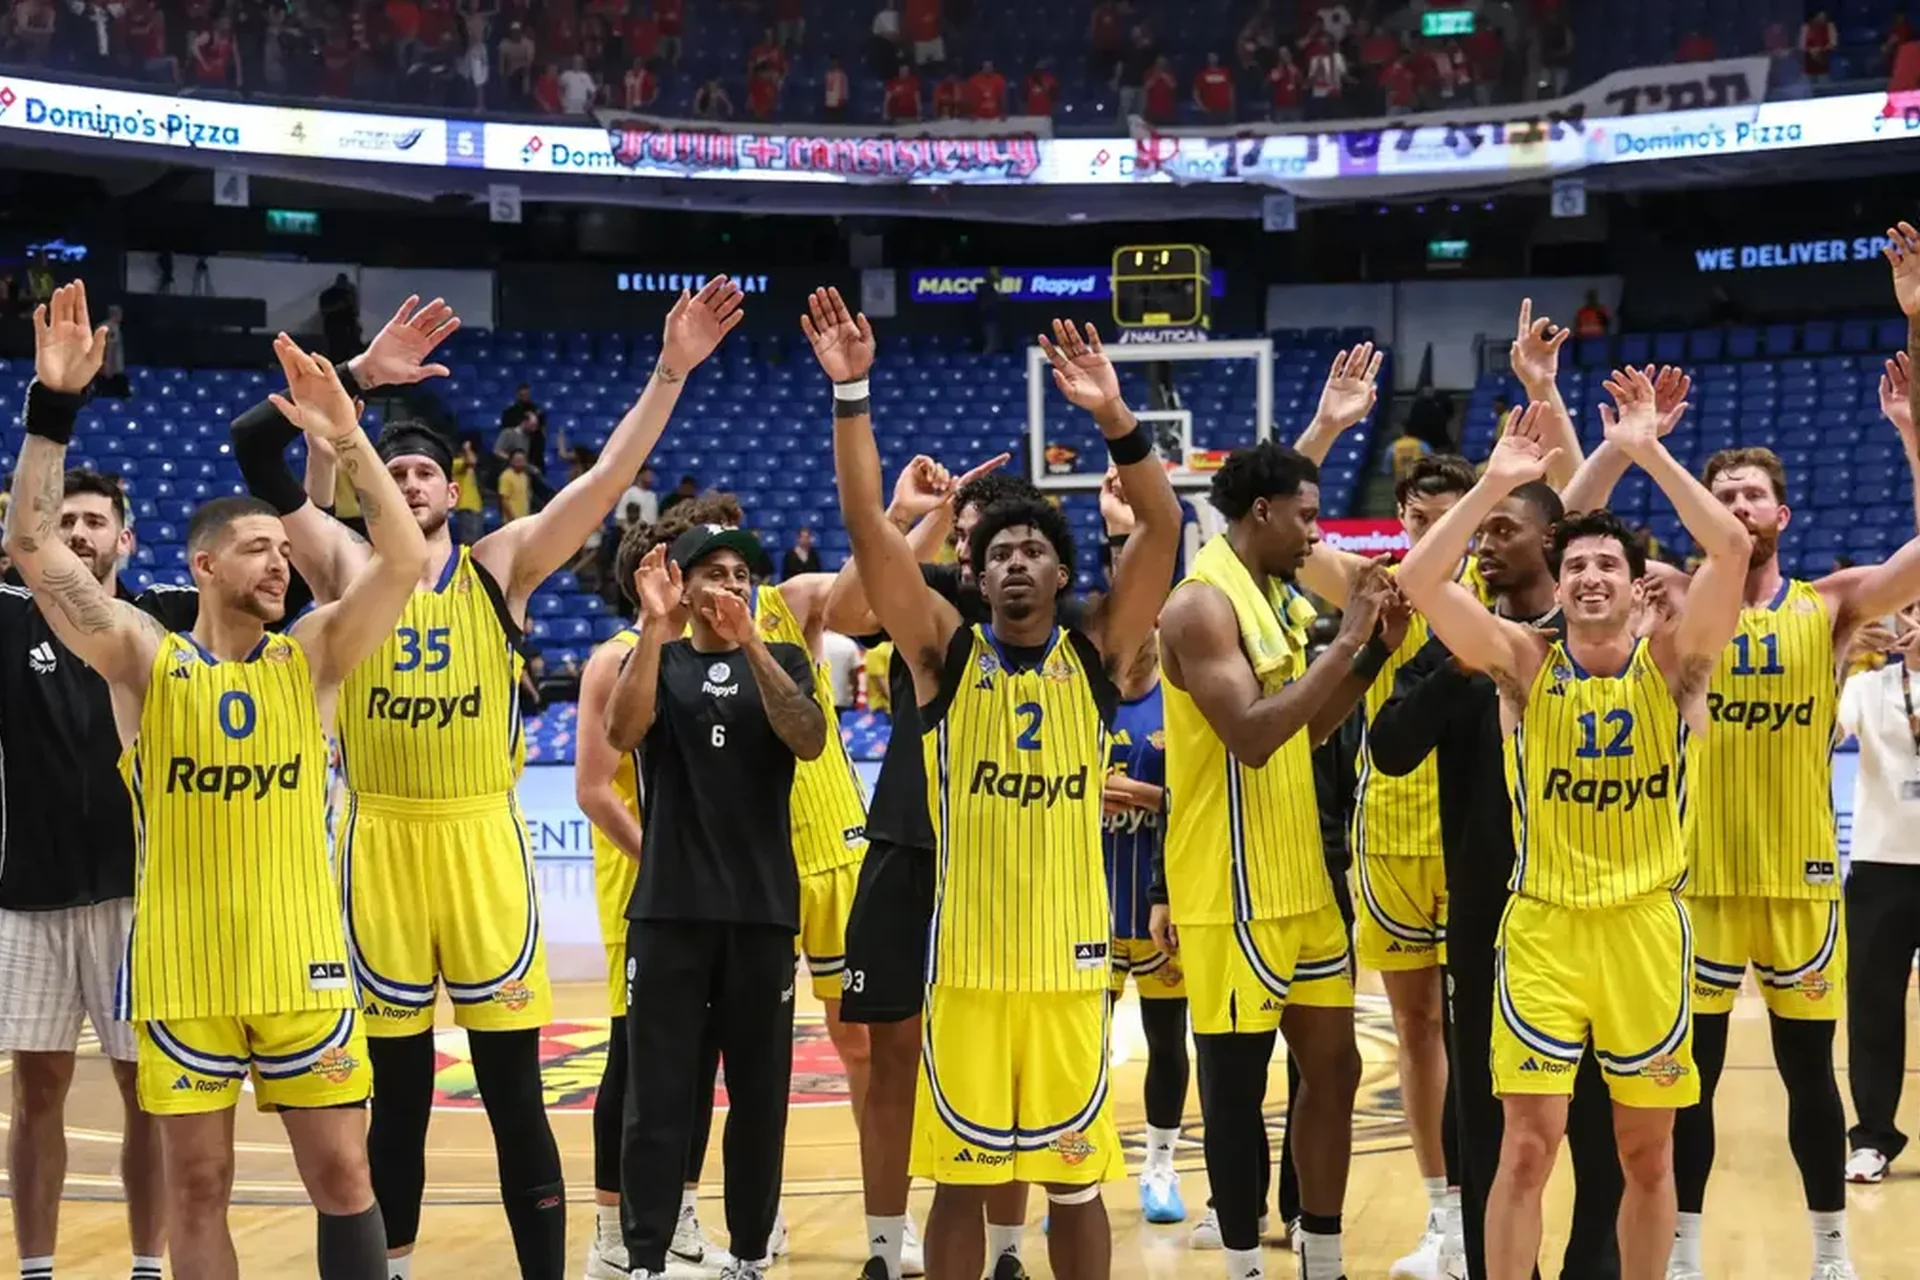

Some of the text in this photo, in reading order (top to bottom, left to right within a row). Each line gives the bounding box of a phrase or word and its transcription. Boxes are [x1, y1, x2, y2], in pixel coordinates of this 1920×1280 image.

[25, 97, 240, 145] Domino's Pizza
[1614, 122, 1801, 154] Domino's Pizza
[1695, 248, 1735, 271] WE
[1740, 239, 1847, 268] DELIVER
[617, 273, 706, 292] BELIEVE
[1031, 275, 1095, 296] Rapyd
[1131, 328, 1196, 343] NAUTICA
[393, 627, 451, 673] 35
[1731, 632, 1784, 675] 11
[366, 686, 482, 729] Rapyd
[701, 681, 738, 697] Rapyd
[218, 690, 256, 739] 0
[1014, 702, 1044, 750] 2
[1707, 691, 1815, 732] Rapyd
[711, 724, 726, 748] 6
[1576, 708, 1634, 758] 12
[166, 753, 302, 802] Rapyd
[969, 760, 1088, 809] Rapyd
[1543, 764, 1670, 812] Rapyd
[383, 1006, 421, 1019] Rapyd
[195, 1078, 230, 1093] Rapyd
